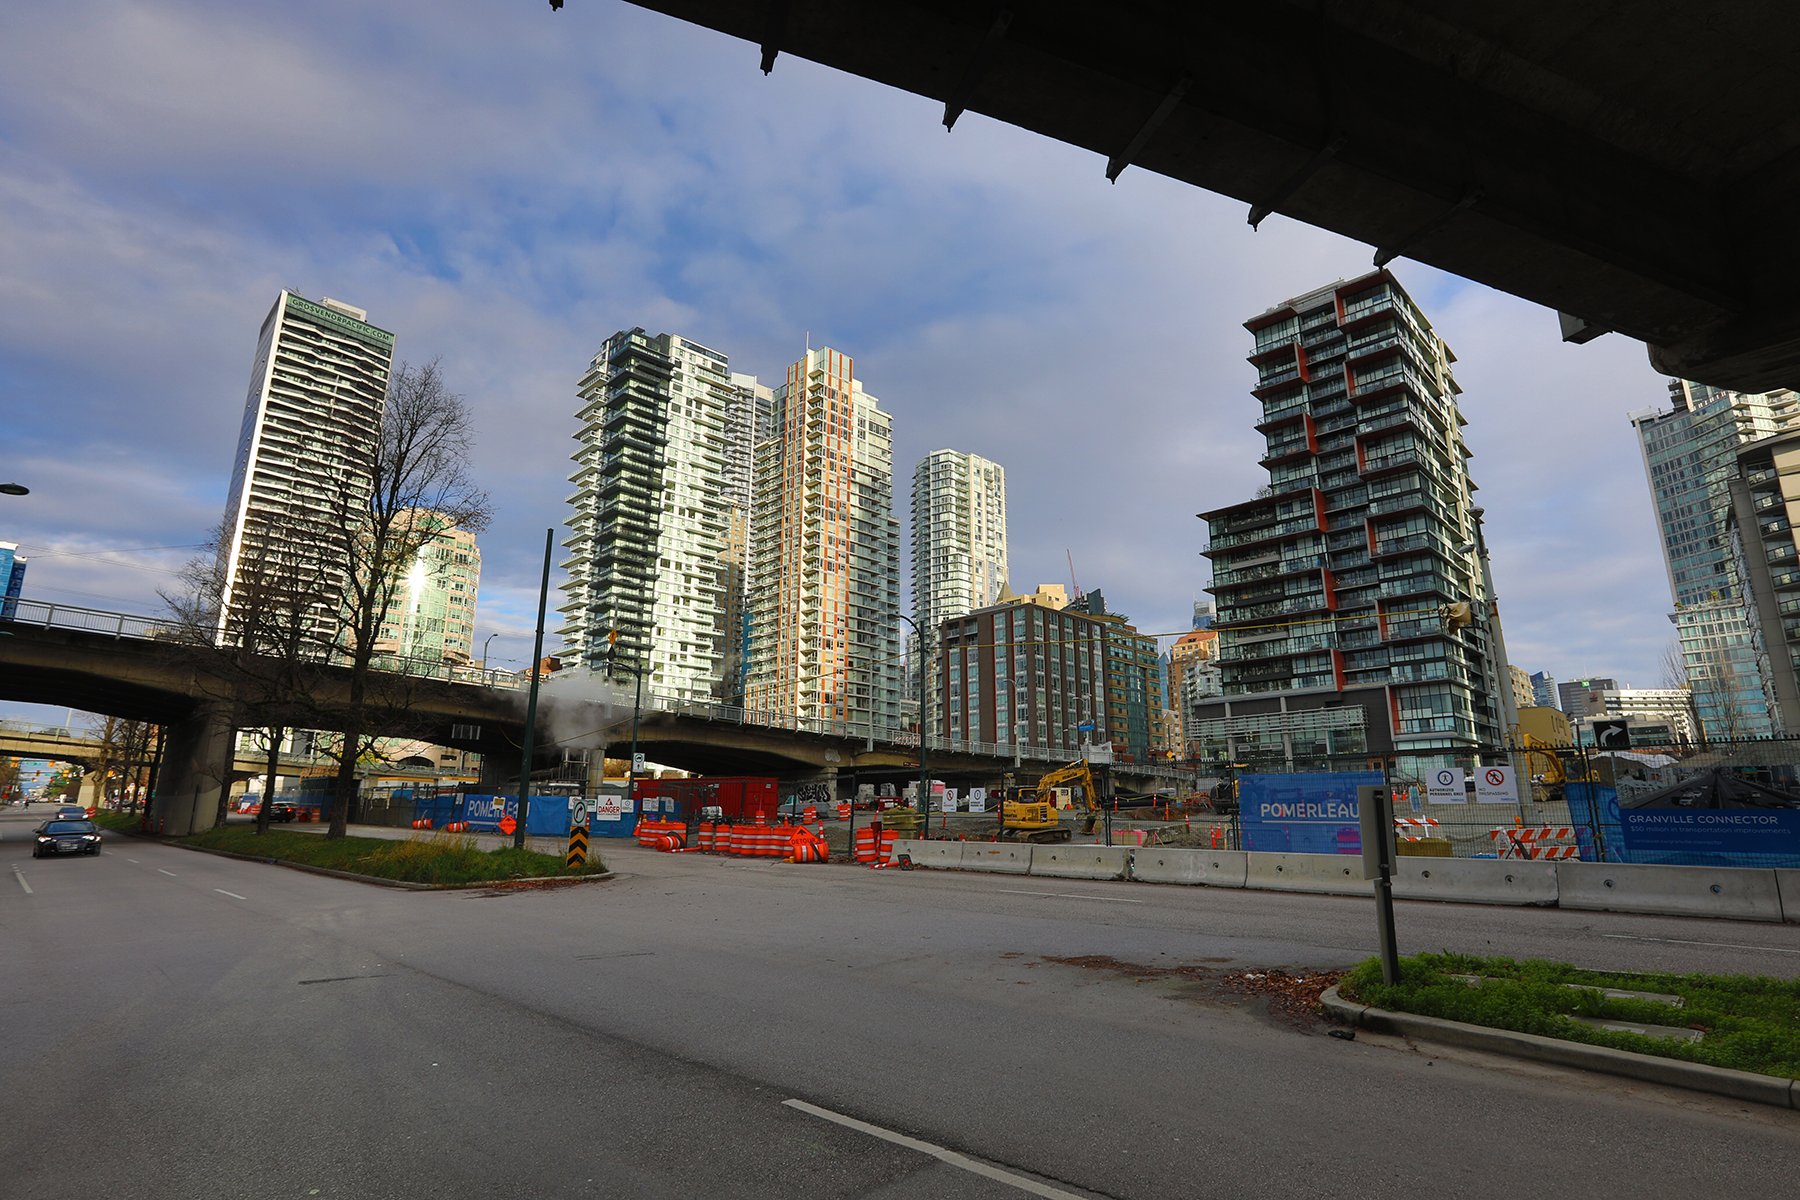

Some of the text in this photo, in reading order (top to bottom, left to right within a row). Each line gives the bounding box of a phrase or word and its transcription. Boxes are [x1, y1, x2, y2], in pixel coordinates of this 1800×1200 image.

[292, 299, 390, 341] GROSVENORPACIFIC.COM
[598, 806, 621, 814] DANGER
[1261, 803, 1360, 818] POMERLEAU
[1628, 815, 1778, 824] GRANVILLE CONNECTOR
[1679, 826, 1733, 834] transportation
